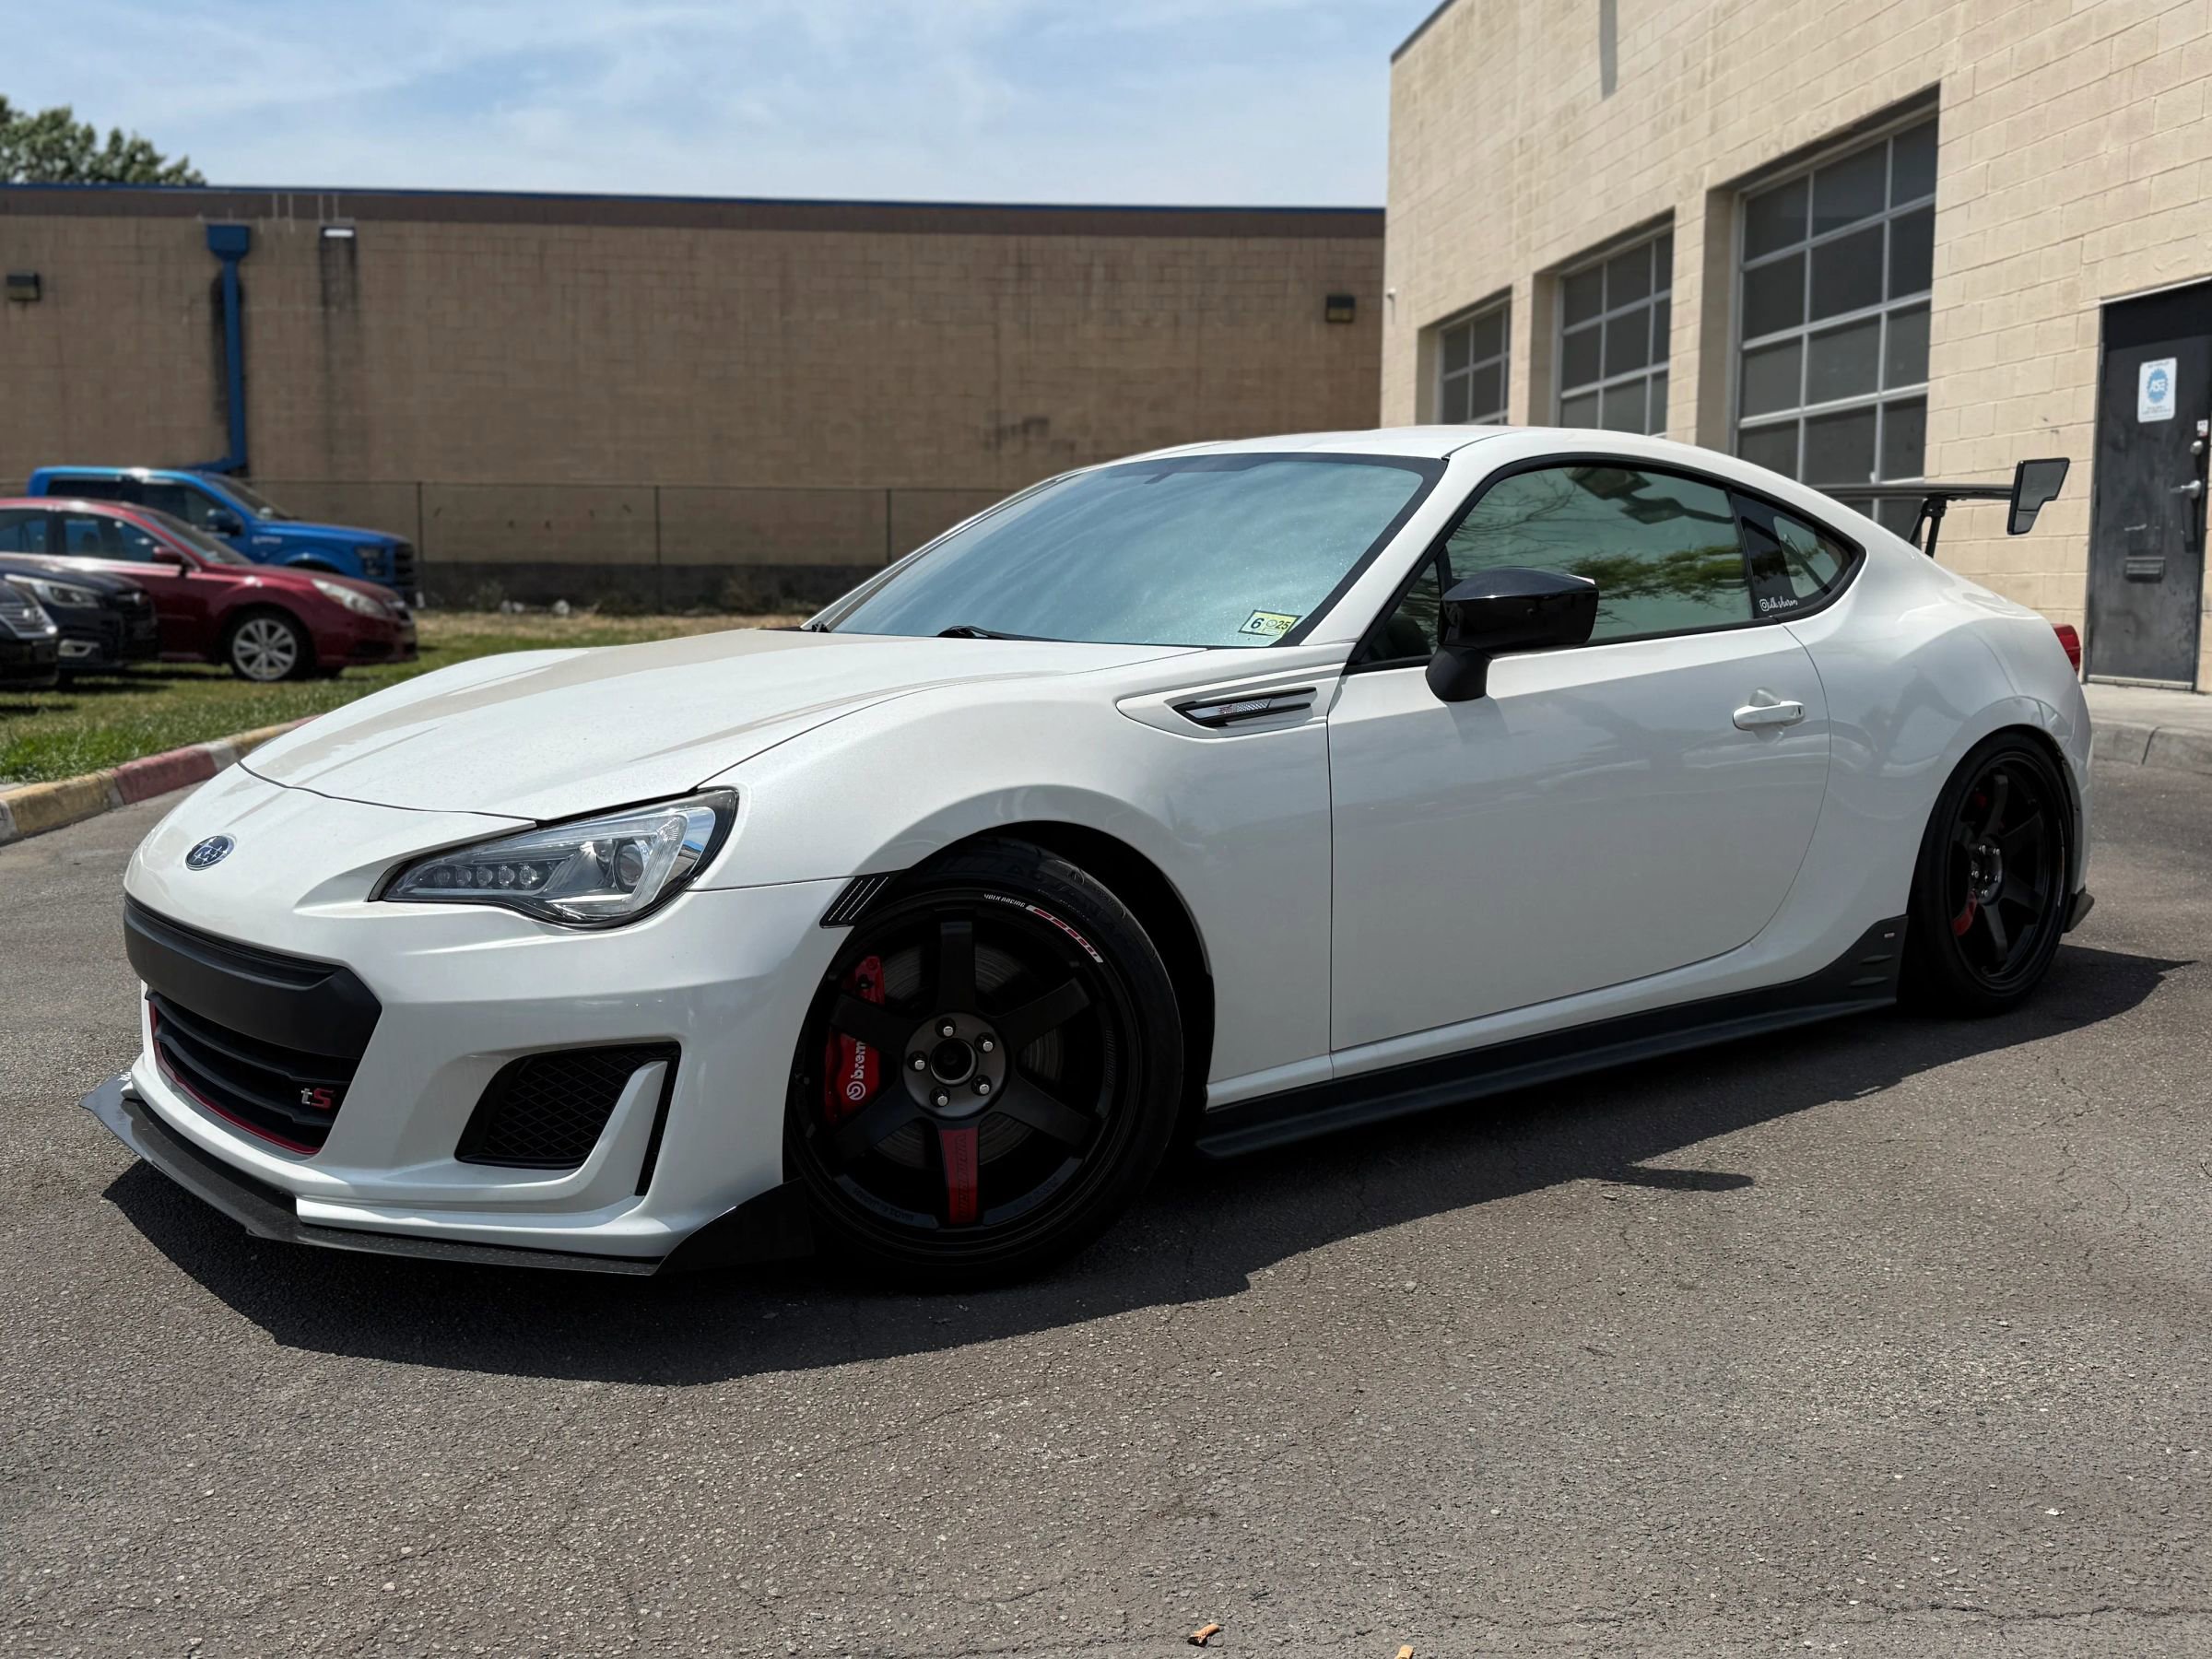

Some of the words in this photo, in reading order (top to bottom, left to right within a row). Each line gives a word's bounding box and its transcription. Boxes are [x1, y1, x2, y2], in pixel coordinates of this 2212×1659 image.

[1251, 618, 1265, 629] 6
[1276, 620, 1291, 630] 25
[851, 1041, 866, 1079] brem
[301, 1088, 334, 1108] tS
